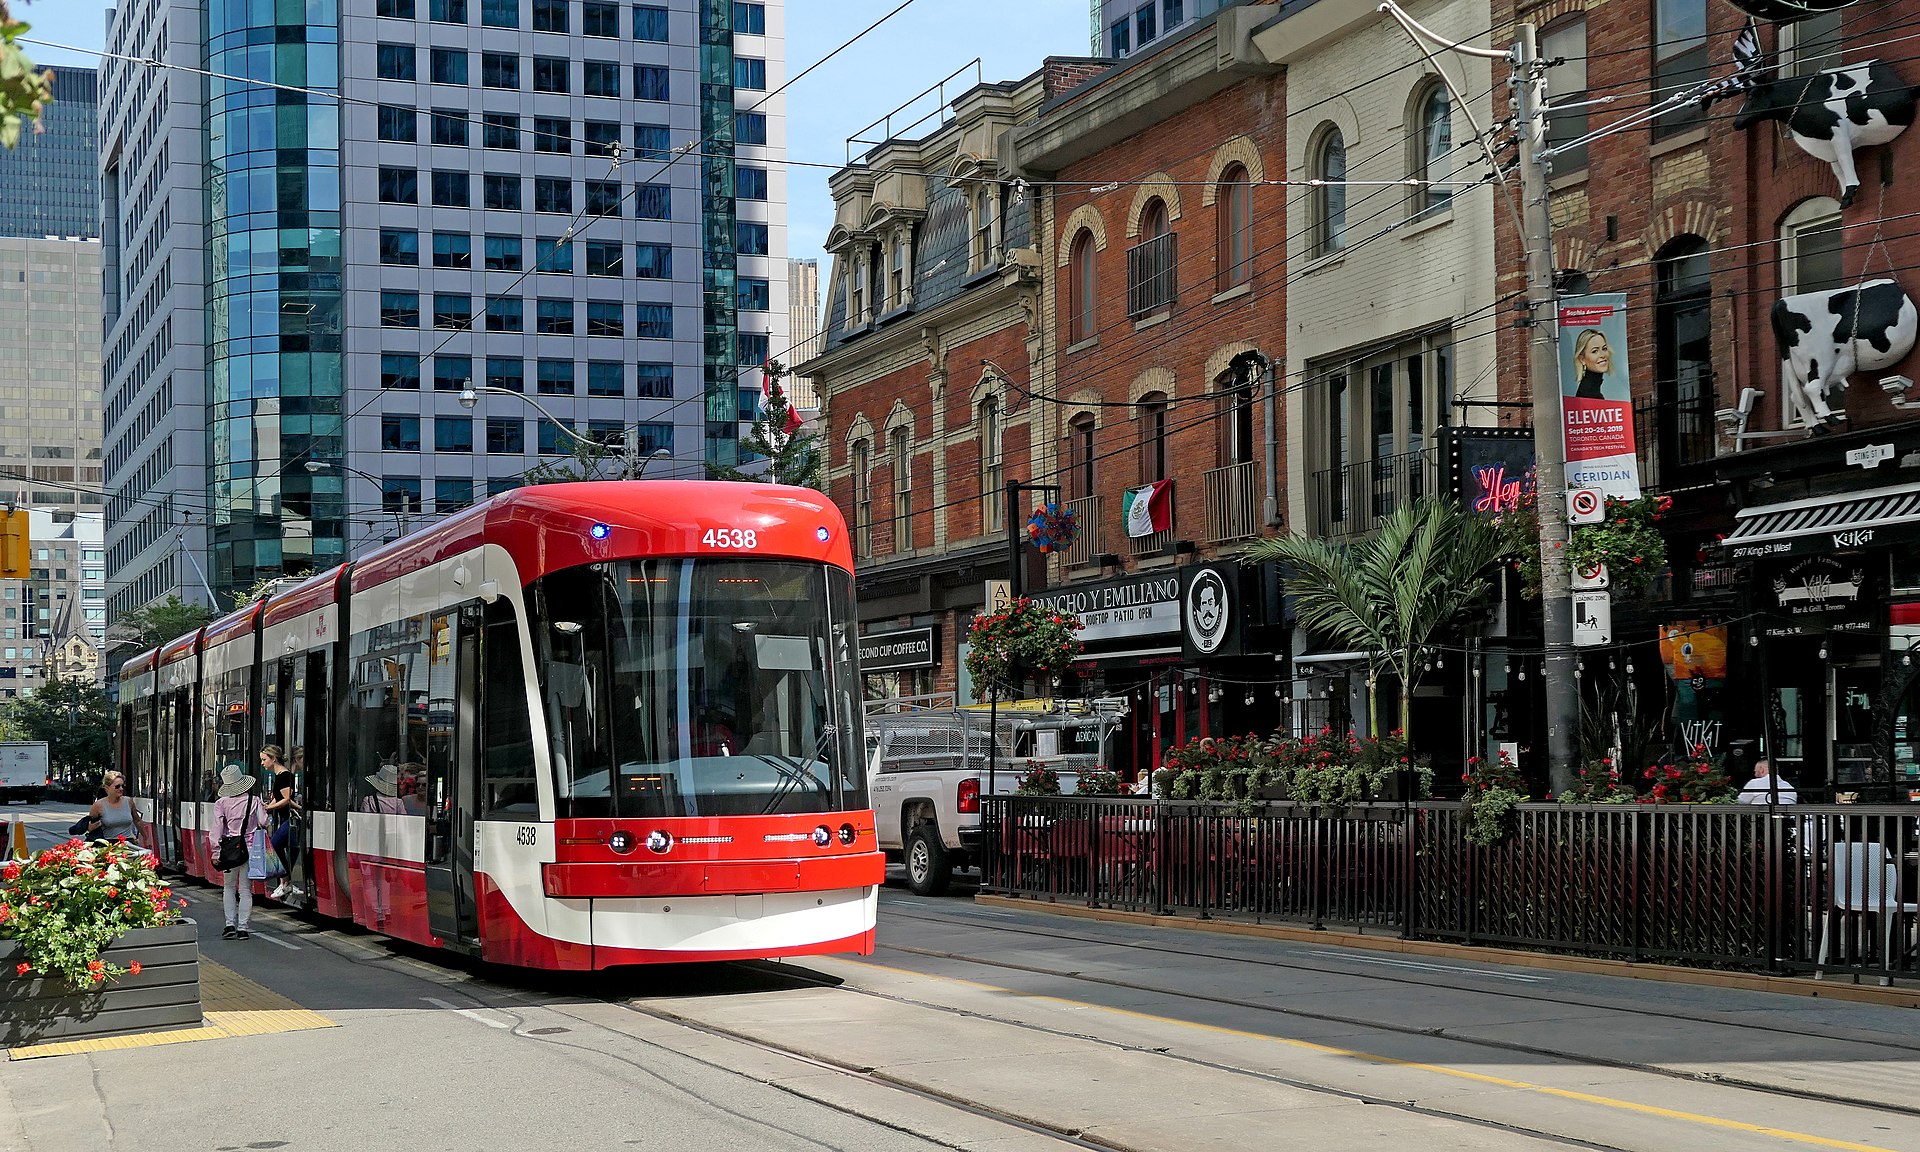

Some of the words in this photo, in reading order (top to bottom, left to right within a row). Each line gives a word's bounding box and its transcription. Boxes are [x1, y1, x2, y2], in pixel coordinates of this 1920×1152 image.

[1567, 408, 1624, 425] ELEVATE
[1584, 426, 1607, 434] 20-26,
[1607, 425, 1624, 433] 2019
[1854, 451, 1869, 461] STING
[1573, 470, 1631, 482] CERIDIAN
[702, 528, 758, 549] 4538
[1733, 548, 1747, 558] 297
[1747, 546, 1764, 557] King
[1773, 541, 1792, 553] West
[1789, 557, 1812, 574] World
[1817, 556, 1842, 568] Famous
[1031, 591, 1085, 614] PANCHO
[1088, 588, 1101, 610] Y
[1103, 577, 1180, 608] EMILIANO
[1085, 613, 1109, 626] ROOFTOP
[1114, 610, 1134, 622] PATIO
[1138, 606, 1153, 618] OPEN
[1803, 605, 1809, 613] &
[859, 647, 879, 659] ECOND
[879, 645, 892, 657] CUP
[892, 642, 916, 656] COFFEE
[916, 640, 928, 653] CO.
[516, 826, 537, 846] 4538
